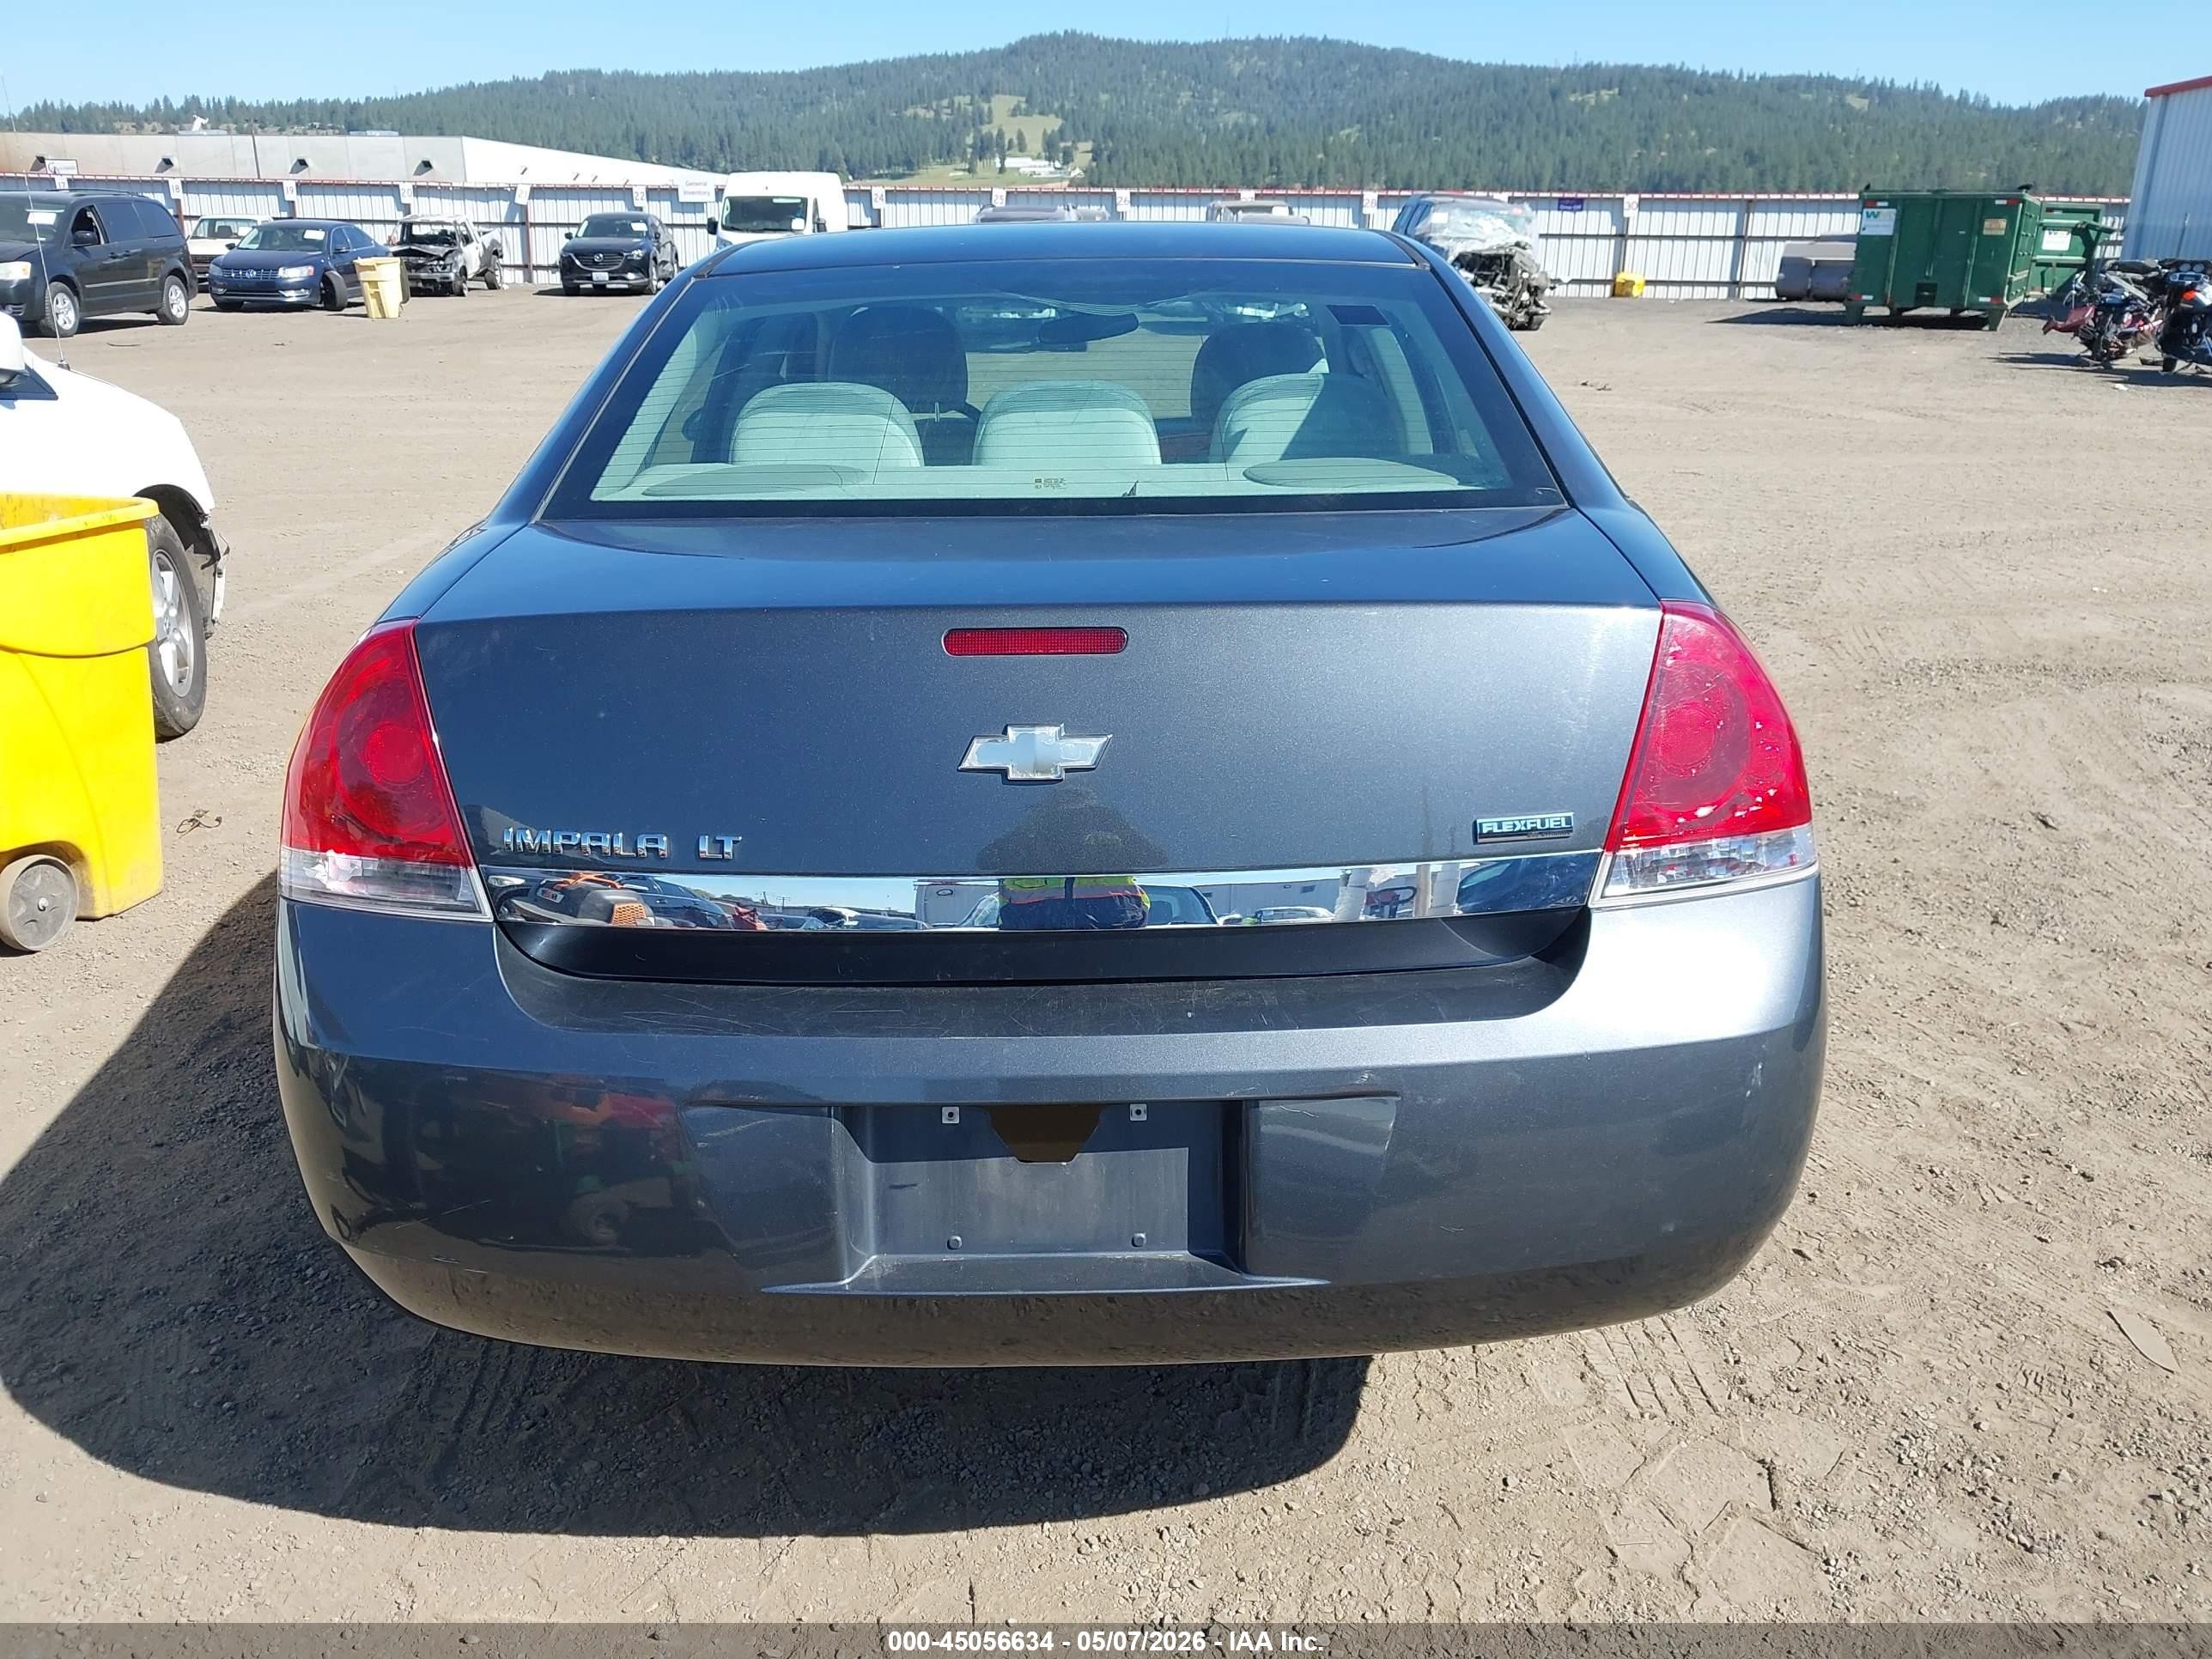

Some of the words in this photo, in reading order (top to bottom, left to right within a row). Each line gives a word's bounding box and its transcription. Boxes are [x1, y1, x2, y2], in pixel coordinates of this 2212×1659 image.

[172, 184, 179, 193] 18
[286, 185, 294, 194] 19
[401, 187, 412, 198] 20
[635, 191, 645, 201] 22
[873, 193, 884, 203] 24
[993, 195, 1004, 205] 25
[1625, 201, 1638, 211] 30
[1482, 817, 1571, 833] FLEXFUEL
[503, 827, 668, 859] IMPALA
[698, 834, 743, 860] LT
